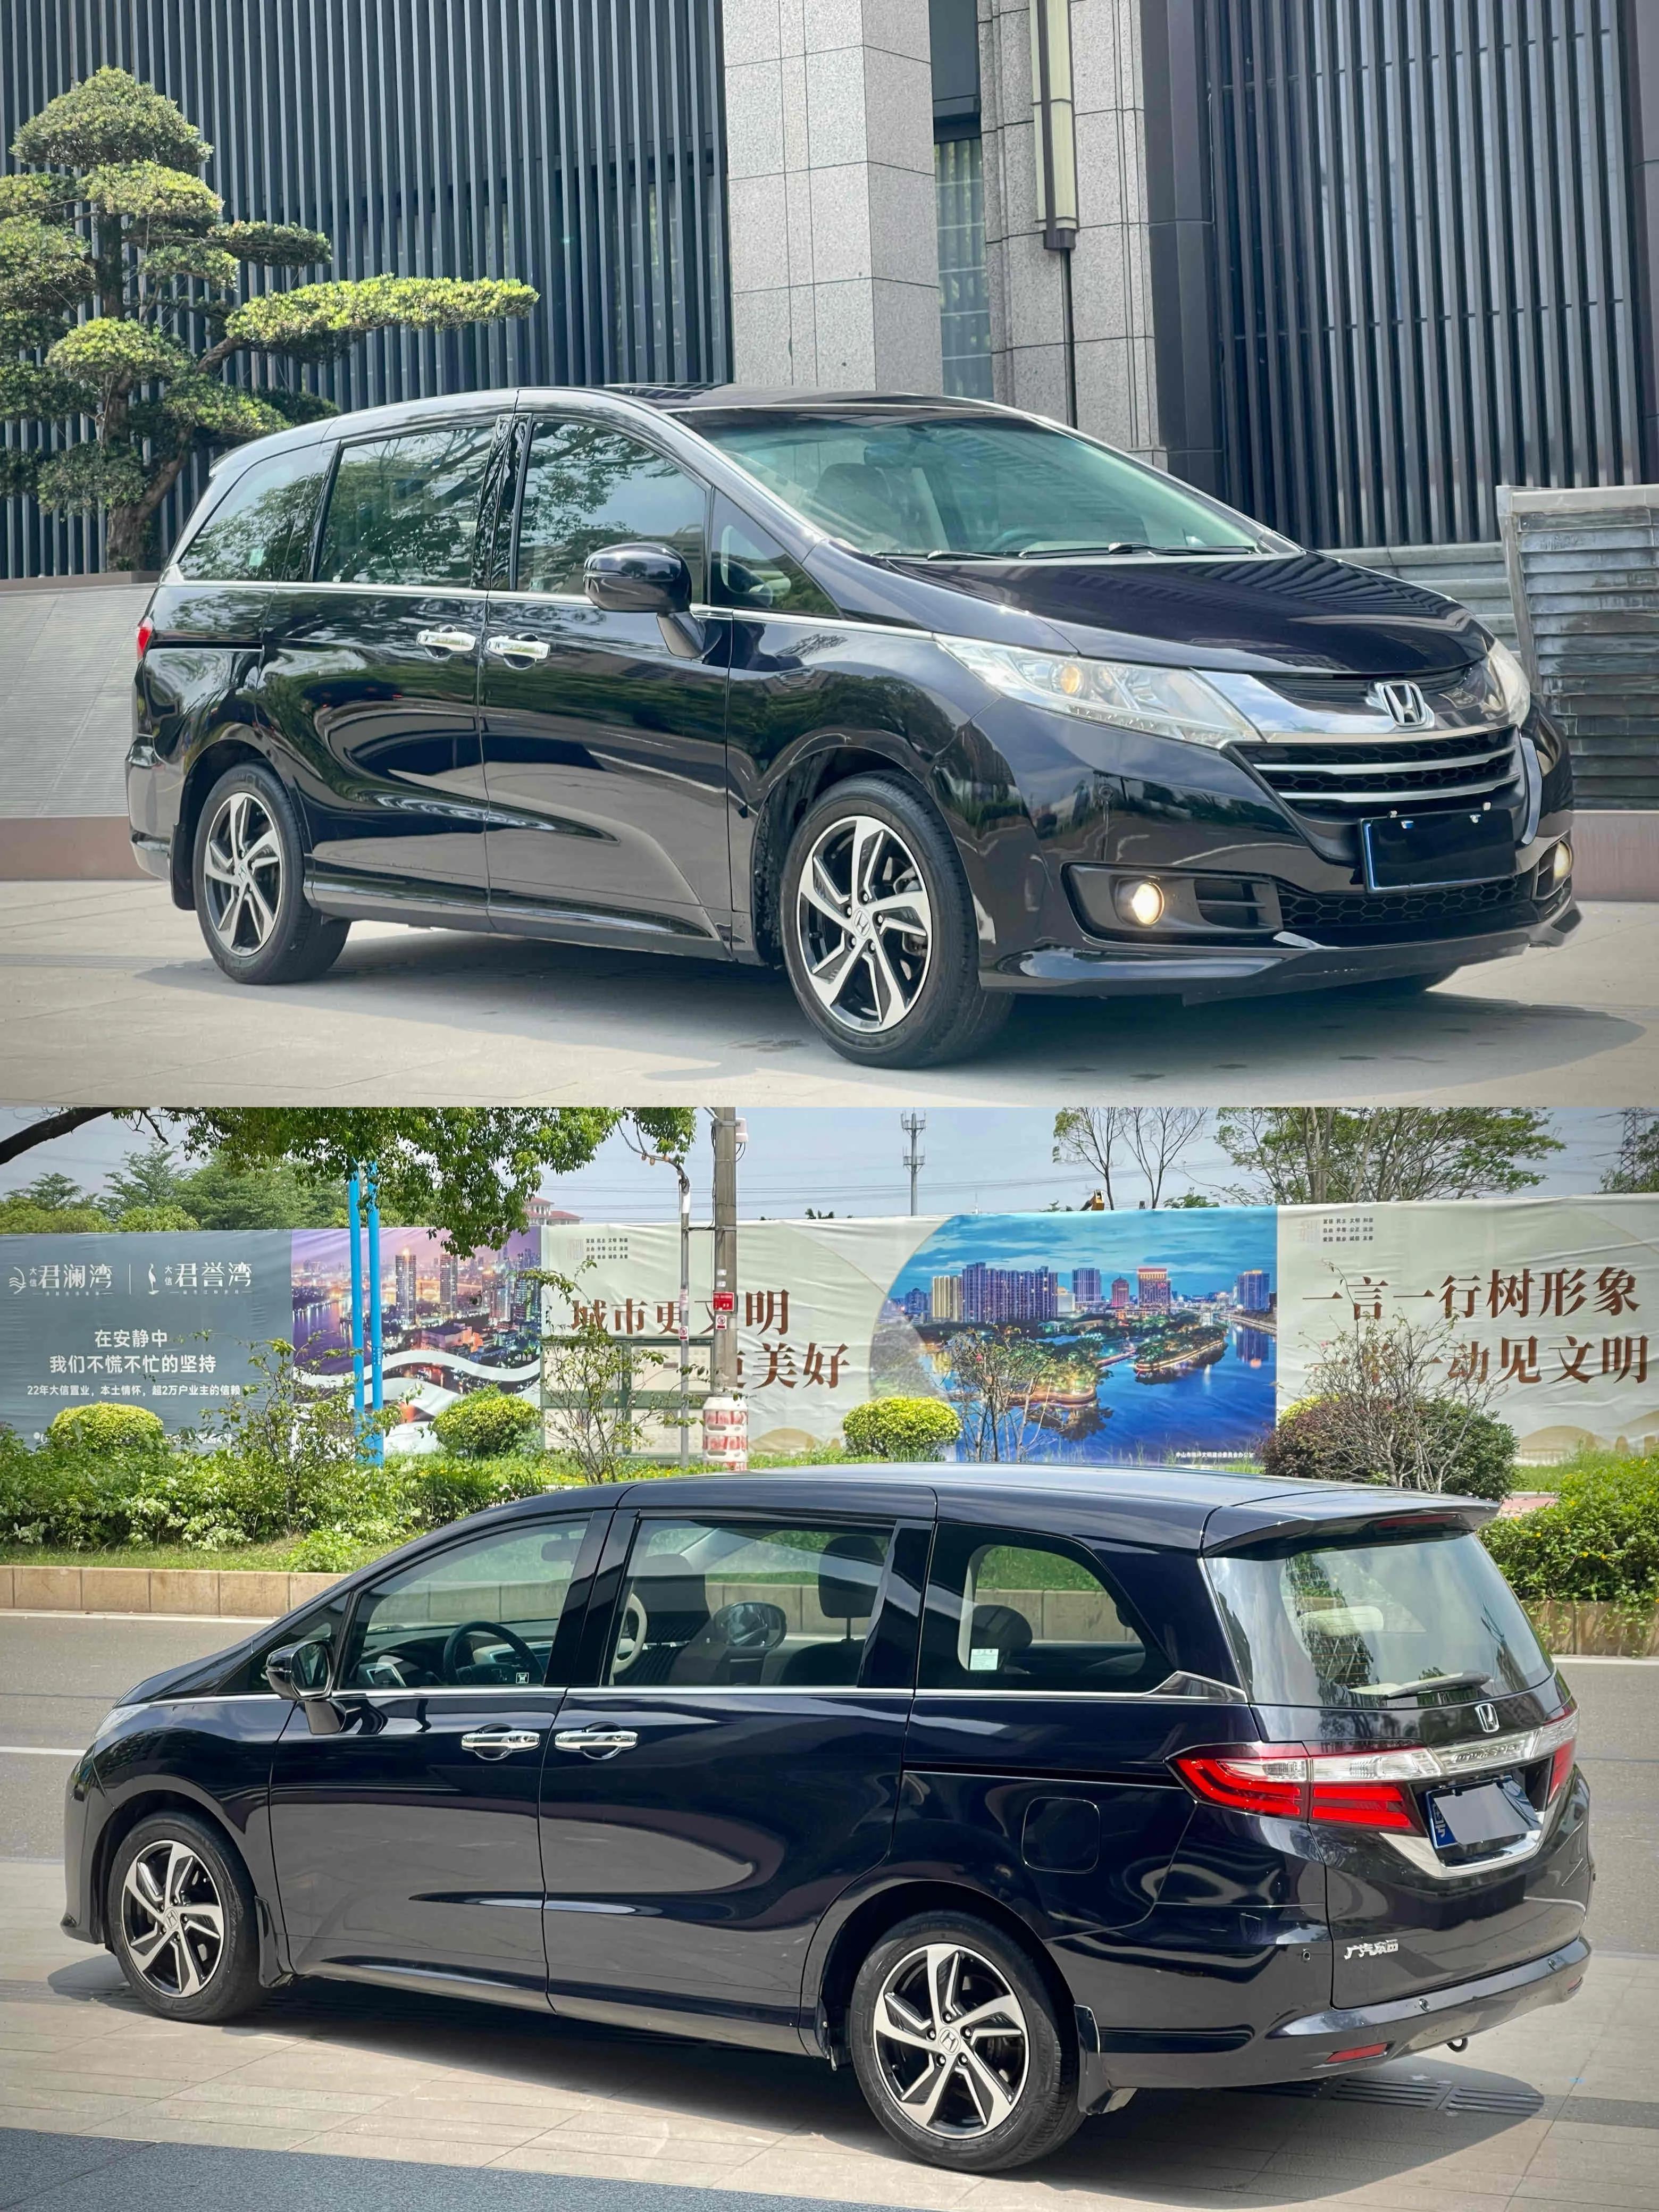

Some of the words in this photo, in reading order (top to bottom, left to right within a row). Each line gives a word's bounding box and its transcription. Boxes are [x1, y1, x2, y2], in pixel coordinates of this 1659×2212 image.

[38, 1263, 114, 1289] 君澜湾
[174, 1261, 252, 1287] 君誉湾
[1302, 1267, 1641, 1320] 一言一行树形象
[95, 1329, 167, 1348] 在安静中
[49, 1354, 216, 1374] 我们不慌不忙的坚持
[737, 1342, 850, 1389] 美好
